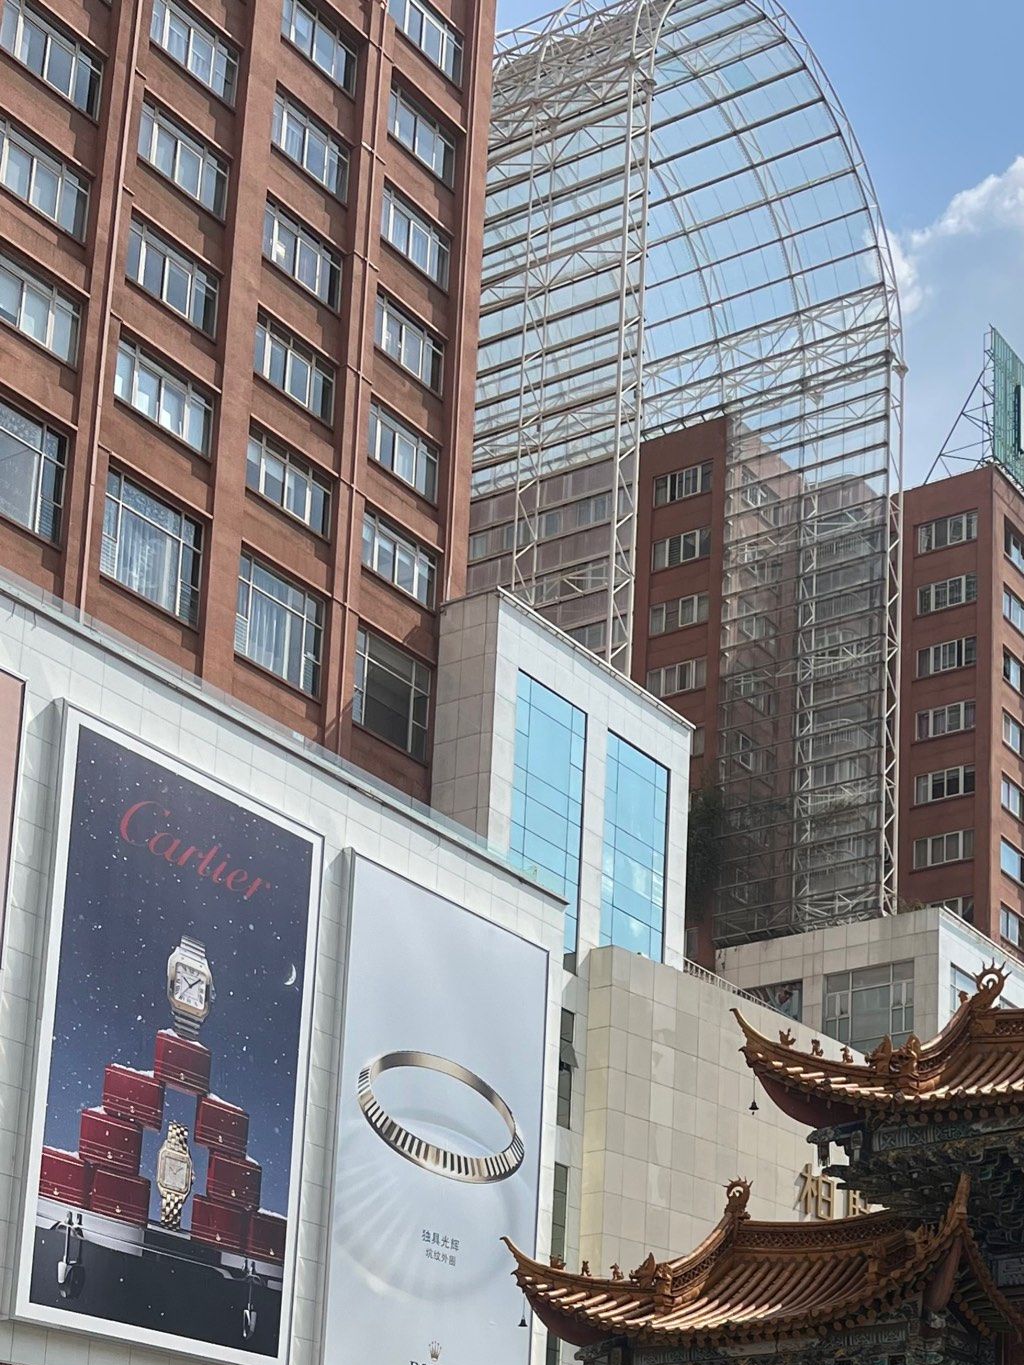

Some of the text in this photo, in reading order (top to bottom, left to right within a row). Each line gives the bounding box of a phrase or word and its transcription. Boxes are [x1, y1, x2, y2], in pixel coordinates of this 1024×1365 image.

[120, 801, 272, 899] Cartier
[422, 1229, 460, 1251] 独具光辉
